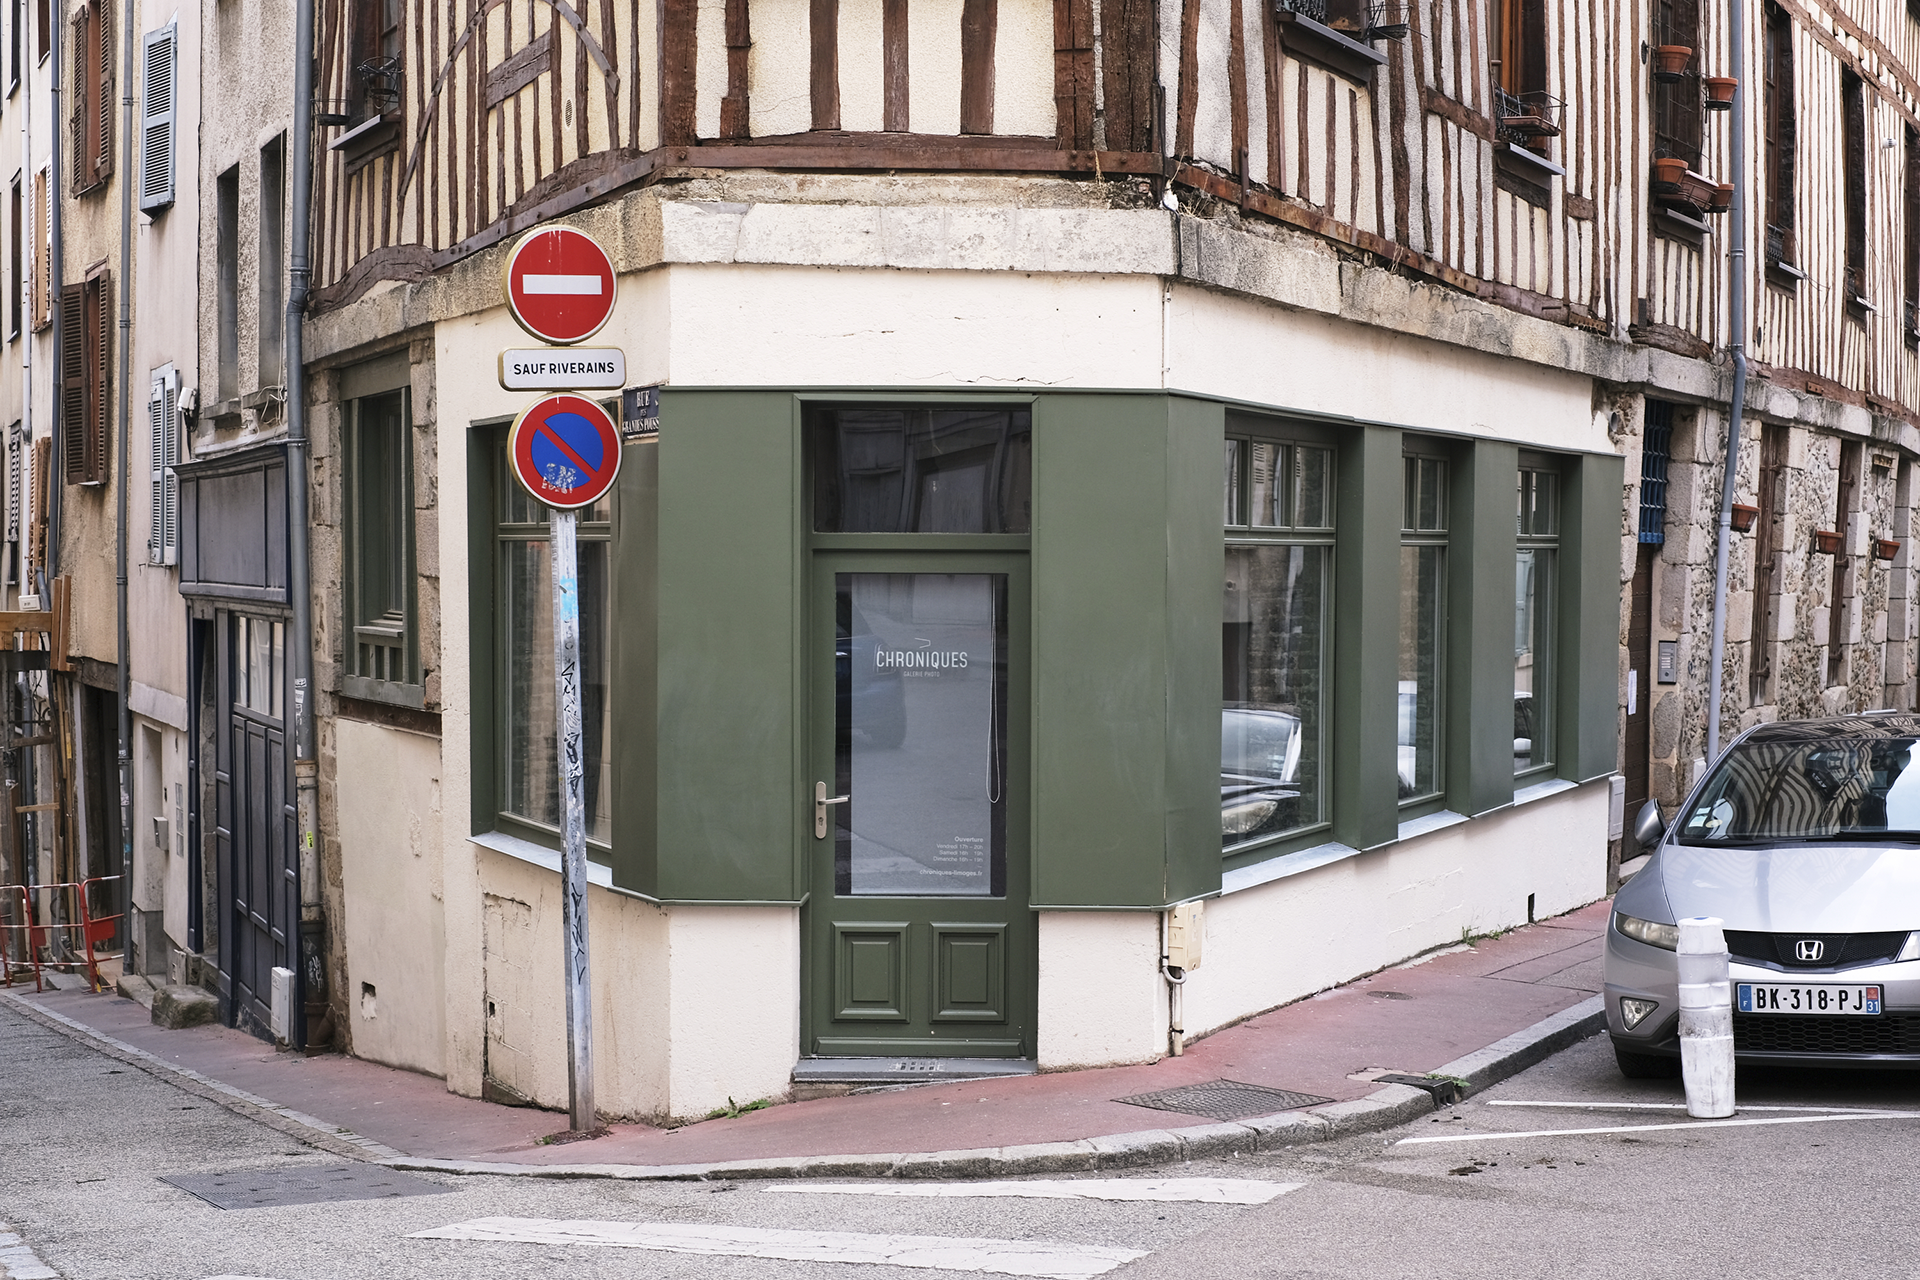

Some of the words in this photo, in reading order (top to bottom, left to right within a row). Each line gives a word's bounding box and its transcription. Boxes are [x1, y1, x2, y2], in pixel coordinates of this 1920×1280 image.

[513, 363, 546, 375] SAUF
[549, 361, 615, 374] RIVERAINS
[636, 390, 650, 408] RUE
[876, 650, 968, 669] CHRONIQUES
[919, 869, 983, 877] chroniques-limoges.fr
[1756, 988, 1863, 1011] BK-318-PJ
[1867, 1000, 1879, 1012] 31
